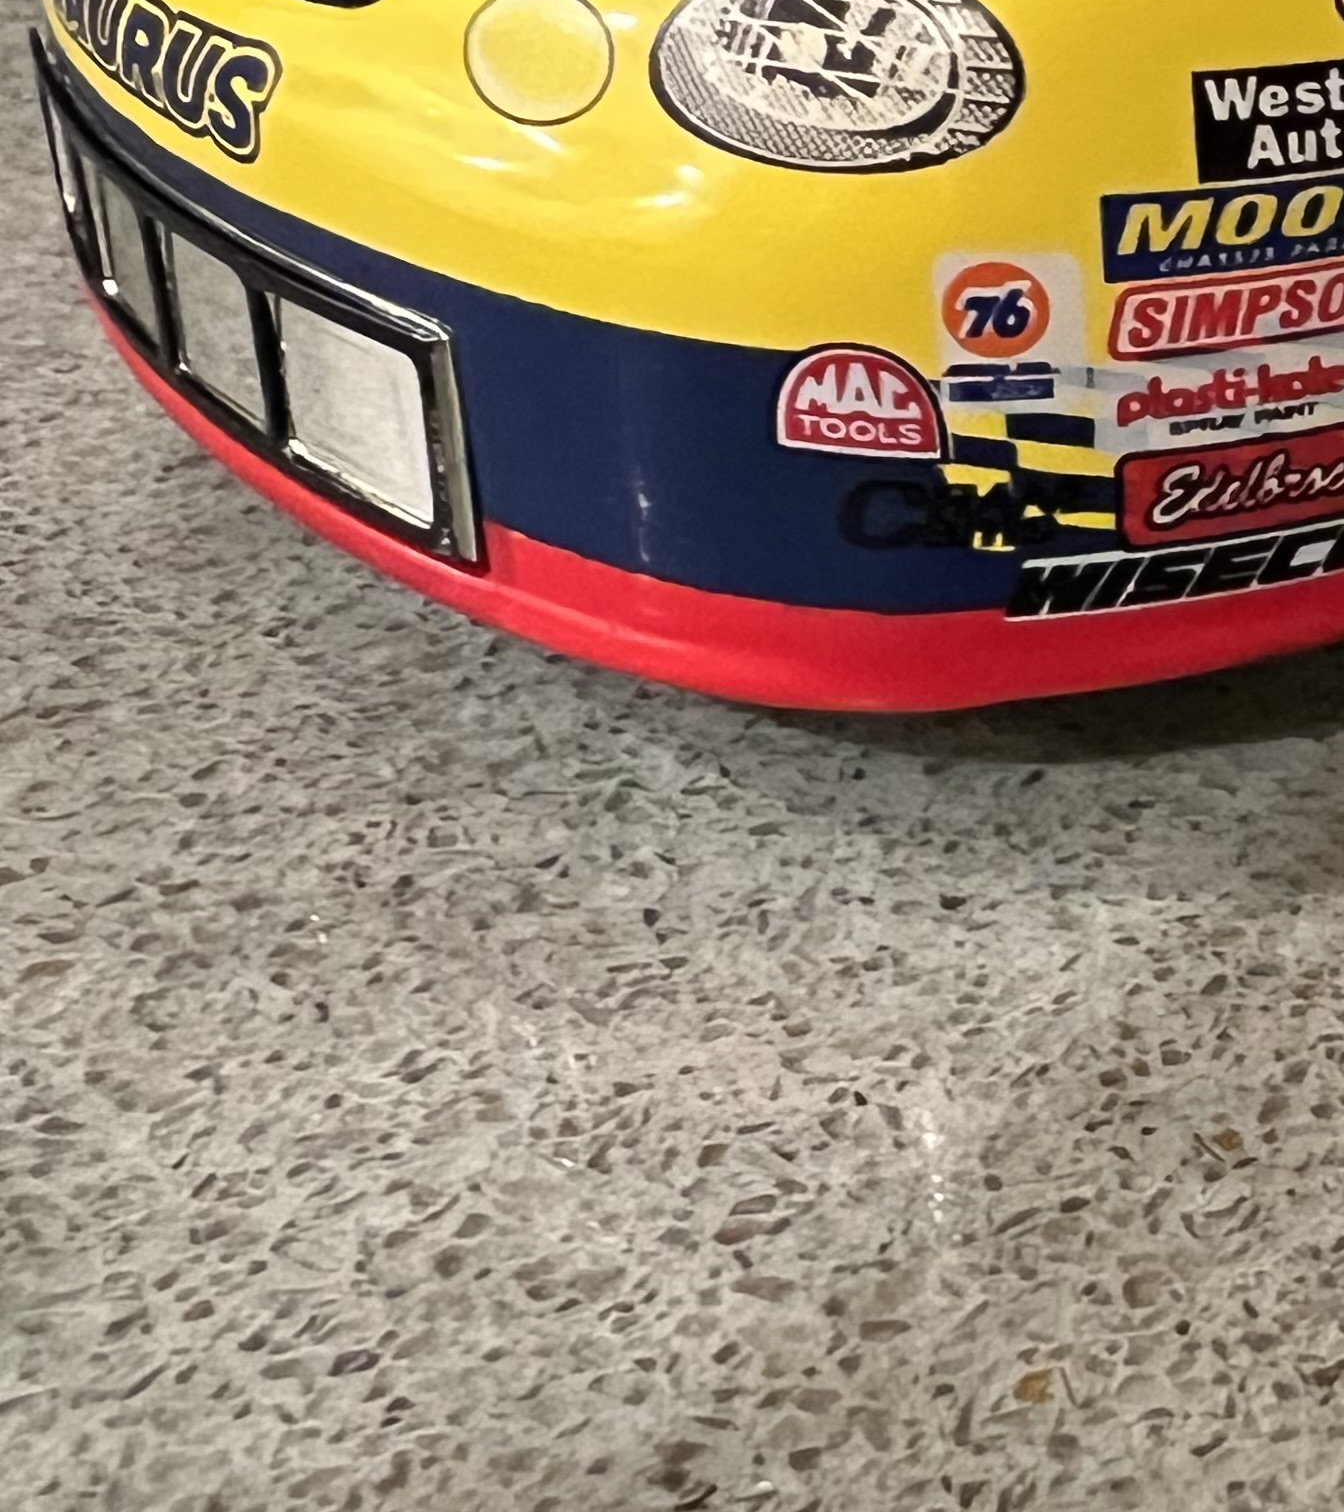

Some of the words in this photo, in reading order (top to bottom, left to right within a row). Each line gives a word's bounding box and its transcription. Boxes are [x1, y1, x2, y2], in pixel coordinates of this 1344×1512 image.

[956, 280, 1032, 339] 76
[794, 361, 923, 419] MAC
[795, 414, 923, 446] TOOLS
